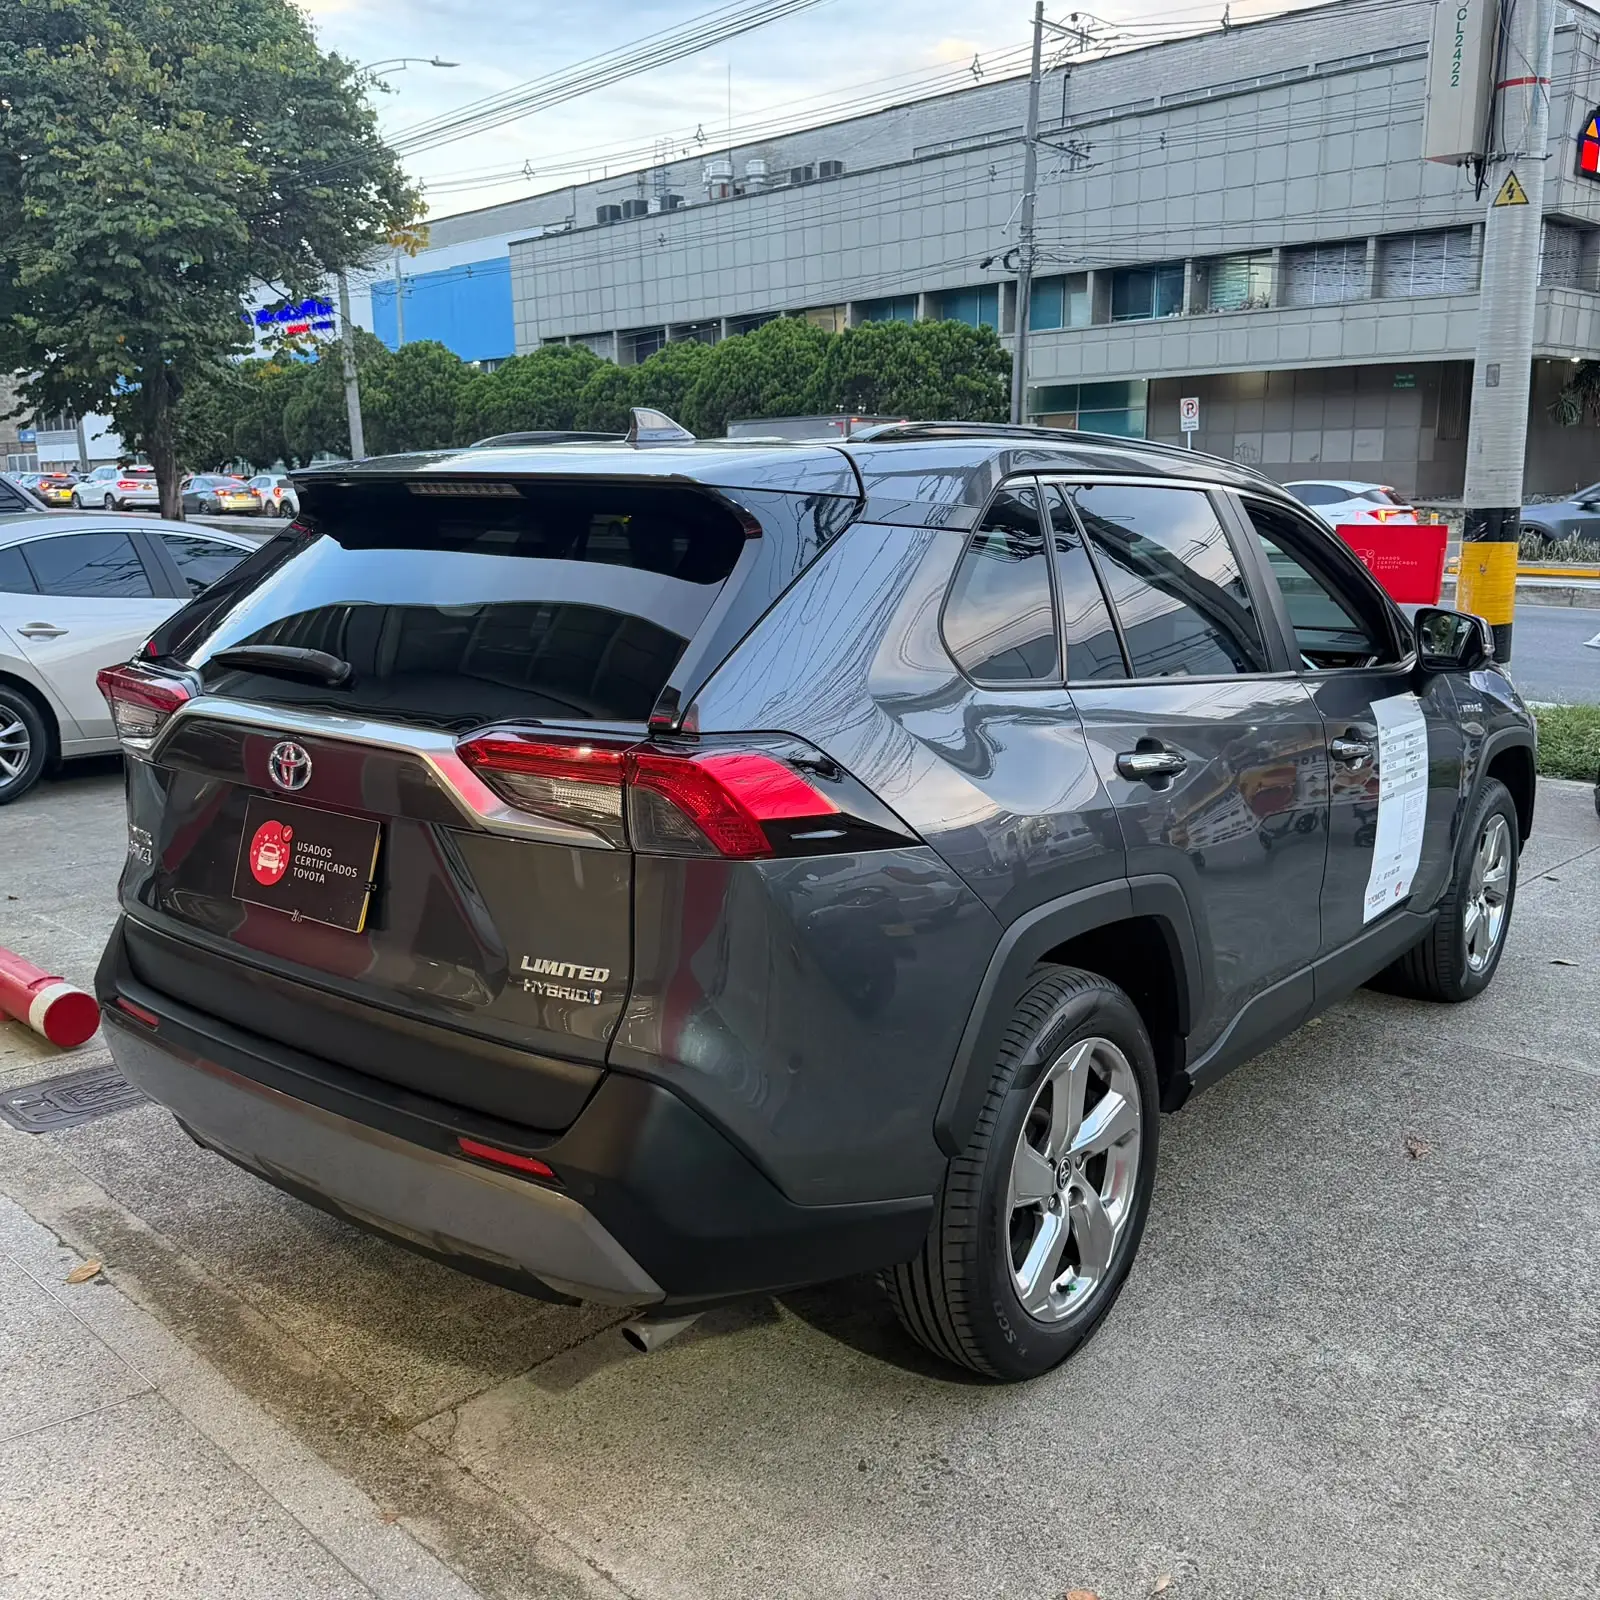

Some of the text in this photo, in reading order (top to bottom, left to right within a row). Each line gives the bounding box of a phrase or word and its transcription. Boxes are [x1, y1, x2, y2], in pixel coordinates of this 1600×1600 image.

[297, 842, 332, 858] USADOS
[293, 868, 325, 883] TOYOTA
[295, 856, 358, 878] CERTIFICADOS
[520, 955, 610, 983] LIMITED
[523, 978, 591, 1003] HYBRID
